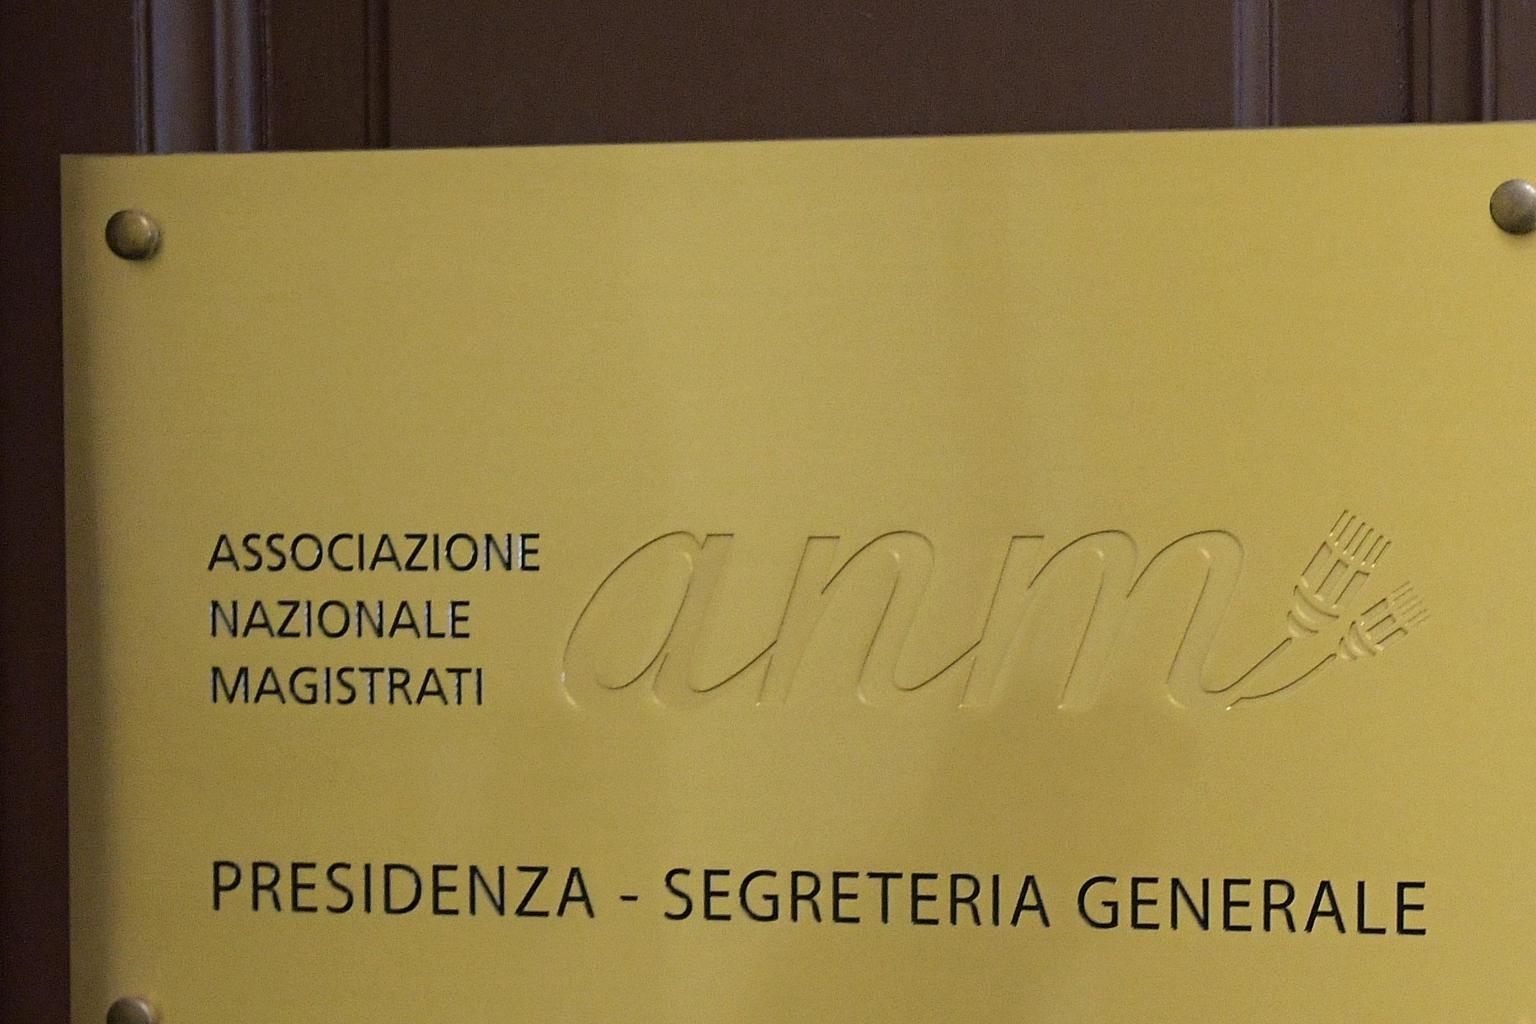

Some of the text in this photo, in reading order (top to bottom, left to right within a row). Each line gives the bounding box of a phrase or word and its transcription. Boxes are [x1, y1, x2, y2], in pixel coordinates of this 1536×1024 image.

[207, 533, 540, 572] ASSOCIAZIONE
[210, 600, 471, 639] NAZIONALE
[562, 529, 1246, 712] anm
[210, 666, 484, 706] MAGISTRATI
[211, 860, 595, 919] PRESIDENZA
[664, 867, 1051, 929] SEGRETERIA
[1077, 875, 1427, 936] GENERALE
